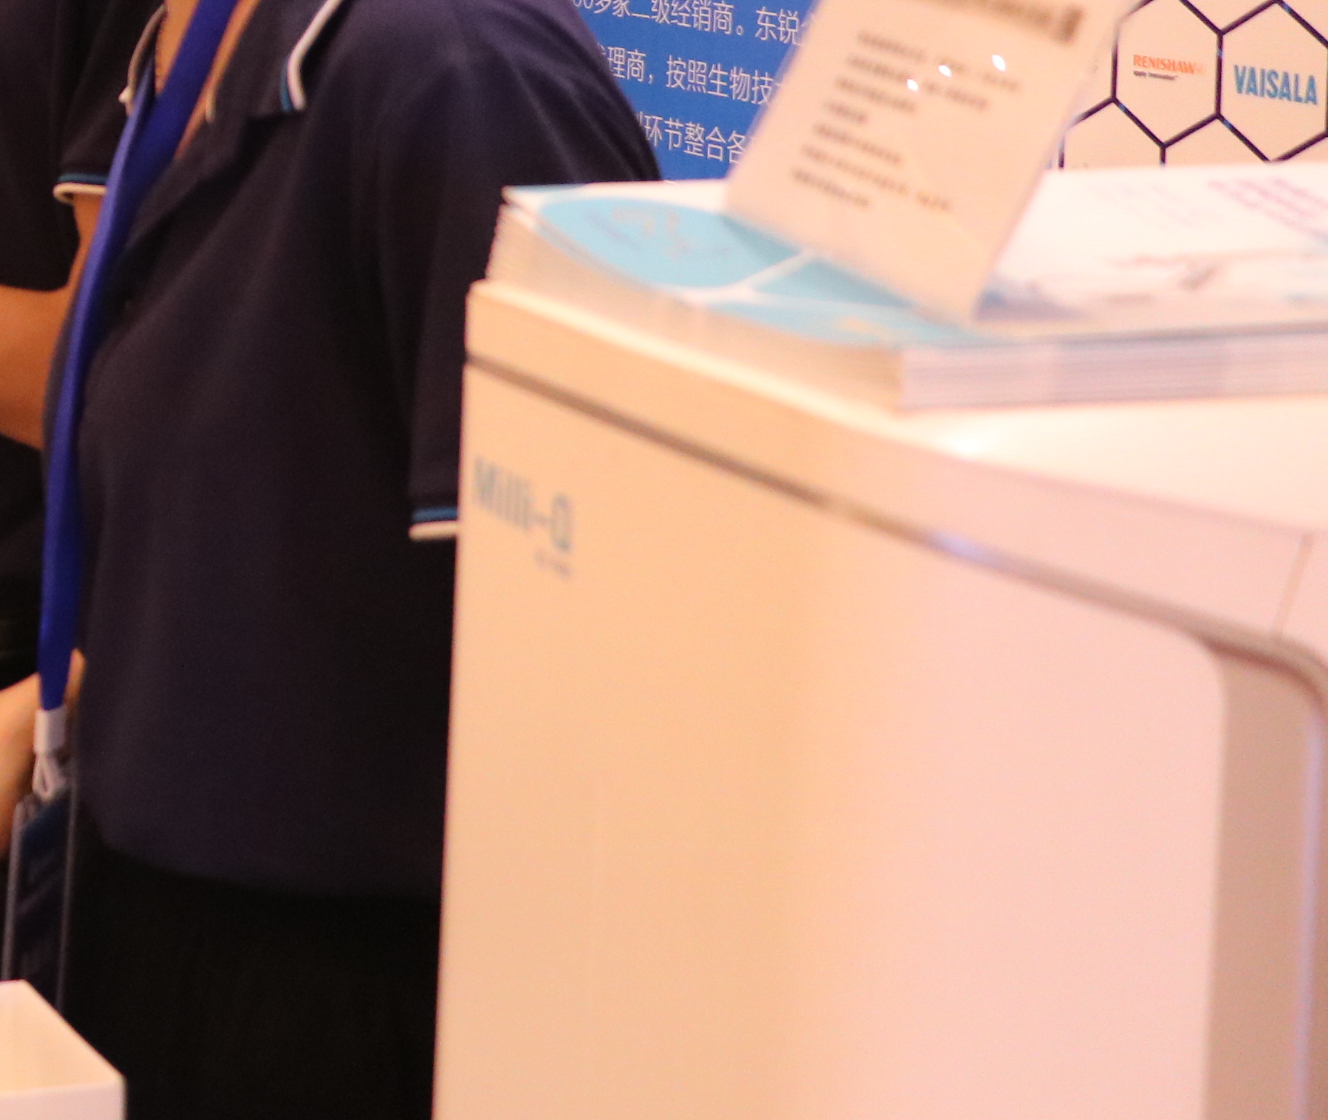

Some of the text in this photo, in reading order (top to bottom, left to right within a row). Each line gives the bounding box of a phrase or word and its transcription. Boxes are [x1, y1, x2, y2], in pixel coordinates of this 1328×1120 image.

[600, 44, 782, 106] 理商，按照生物技
[1233, 64, 1319, 106] VAISALA
[639, 111, 746, 164] 环节整合各
